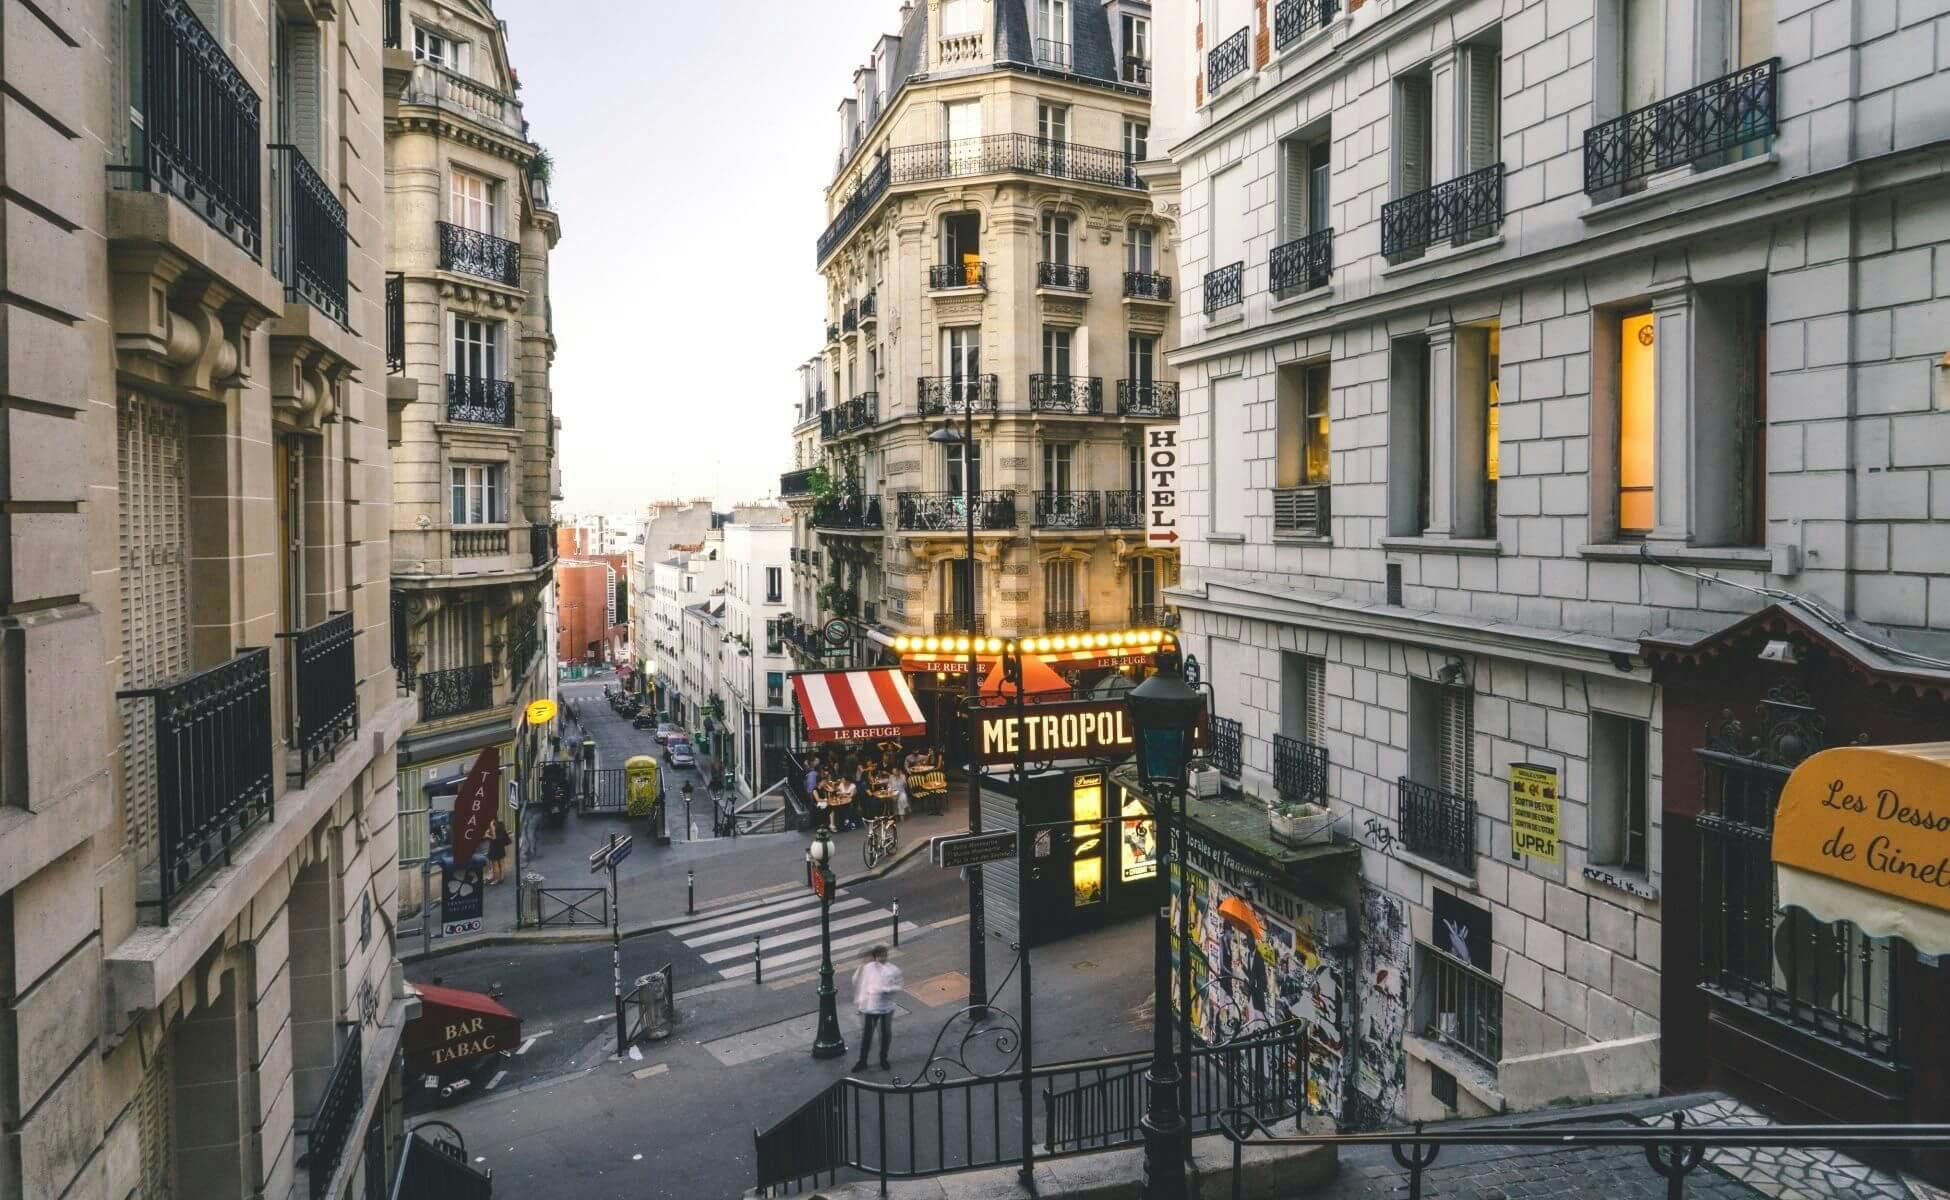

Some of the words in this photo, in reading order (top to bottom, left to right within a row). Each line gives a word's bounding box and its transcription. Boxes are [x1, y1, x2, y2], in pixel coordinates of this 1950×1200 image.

[1149, 430, 1177, 527] HOTEL
[927, 662, 941, 671] LE
[943, 663, 986, 672] REFUE
[1097, 659, 1110, 668] LE
[834, 730, 850, 740] LE
[853, 727, 901, 739] REFUGE
[982, 710, 1133, 755] METROPOL
[464, 771, 491, 840] TABAC
[1821, 779, 1868, 814] Les
[1877, 789, 1950, 832] Desso
[1822, 826, 1857, 862] de
[1866, 835, 1950, 888] Ginet
[445, 919, 482, 935] LOTO
[444, 1017, 484, 1040] BAR
[432, 1035, 497, 1064] TABAC
